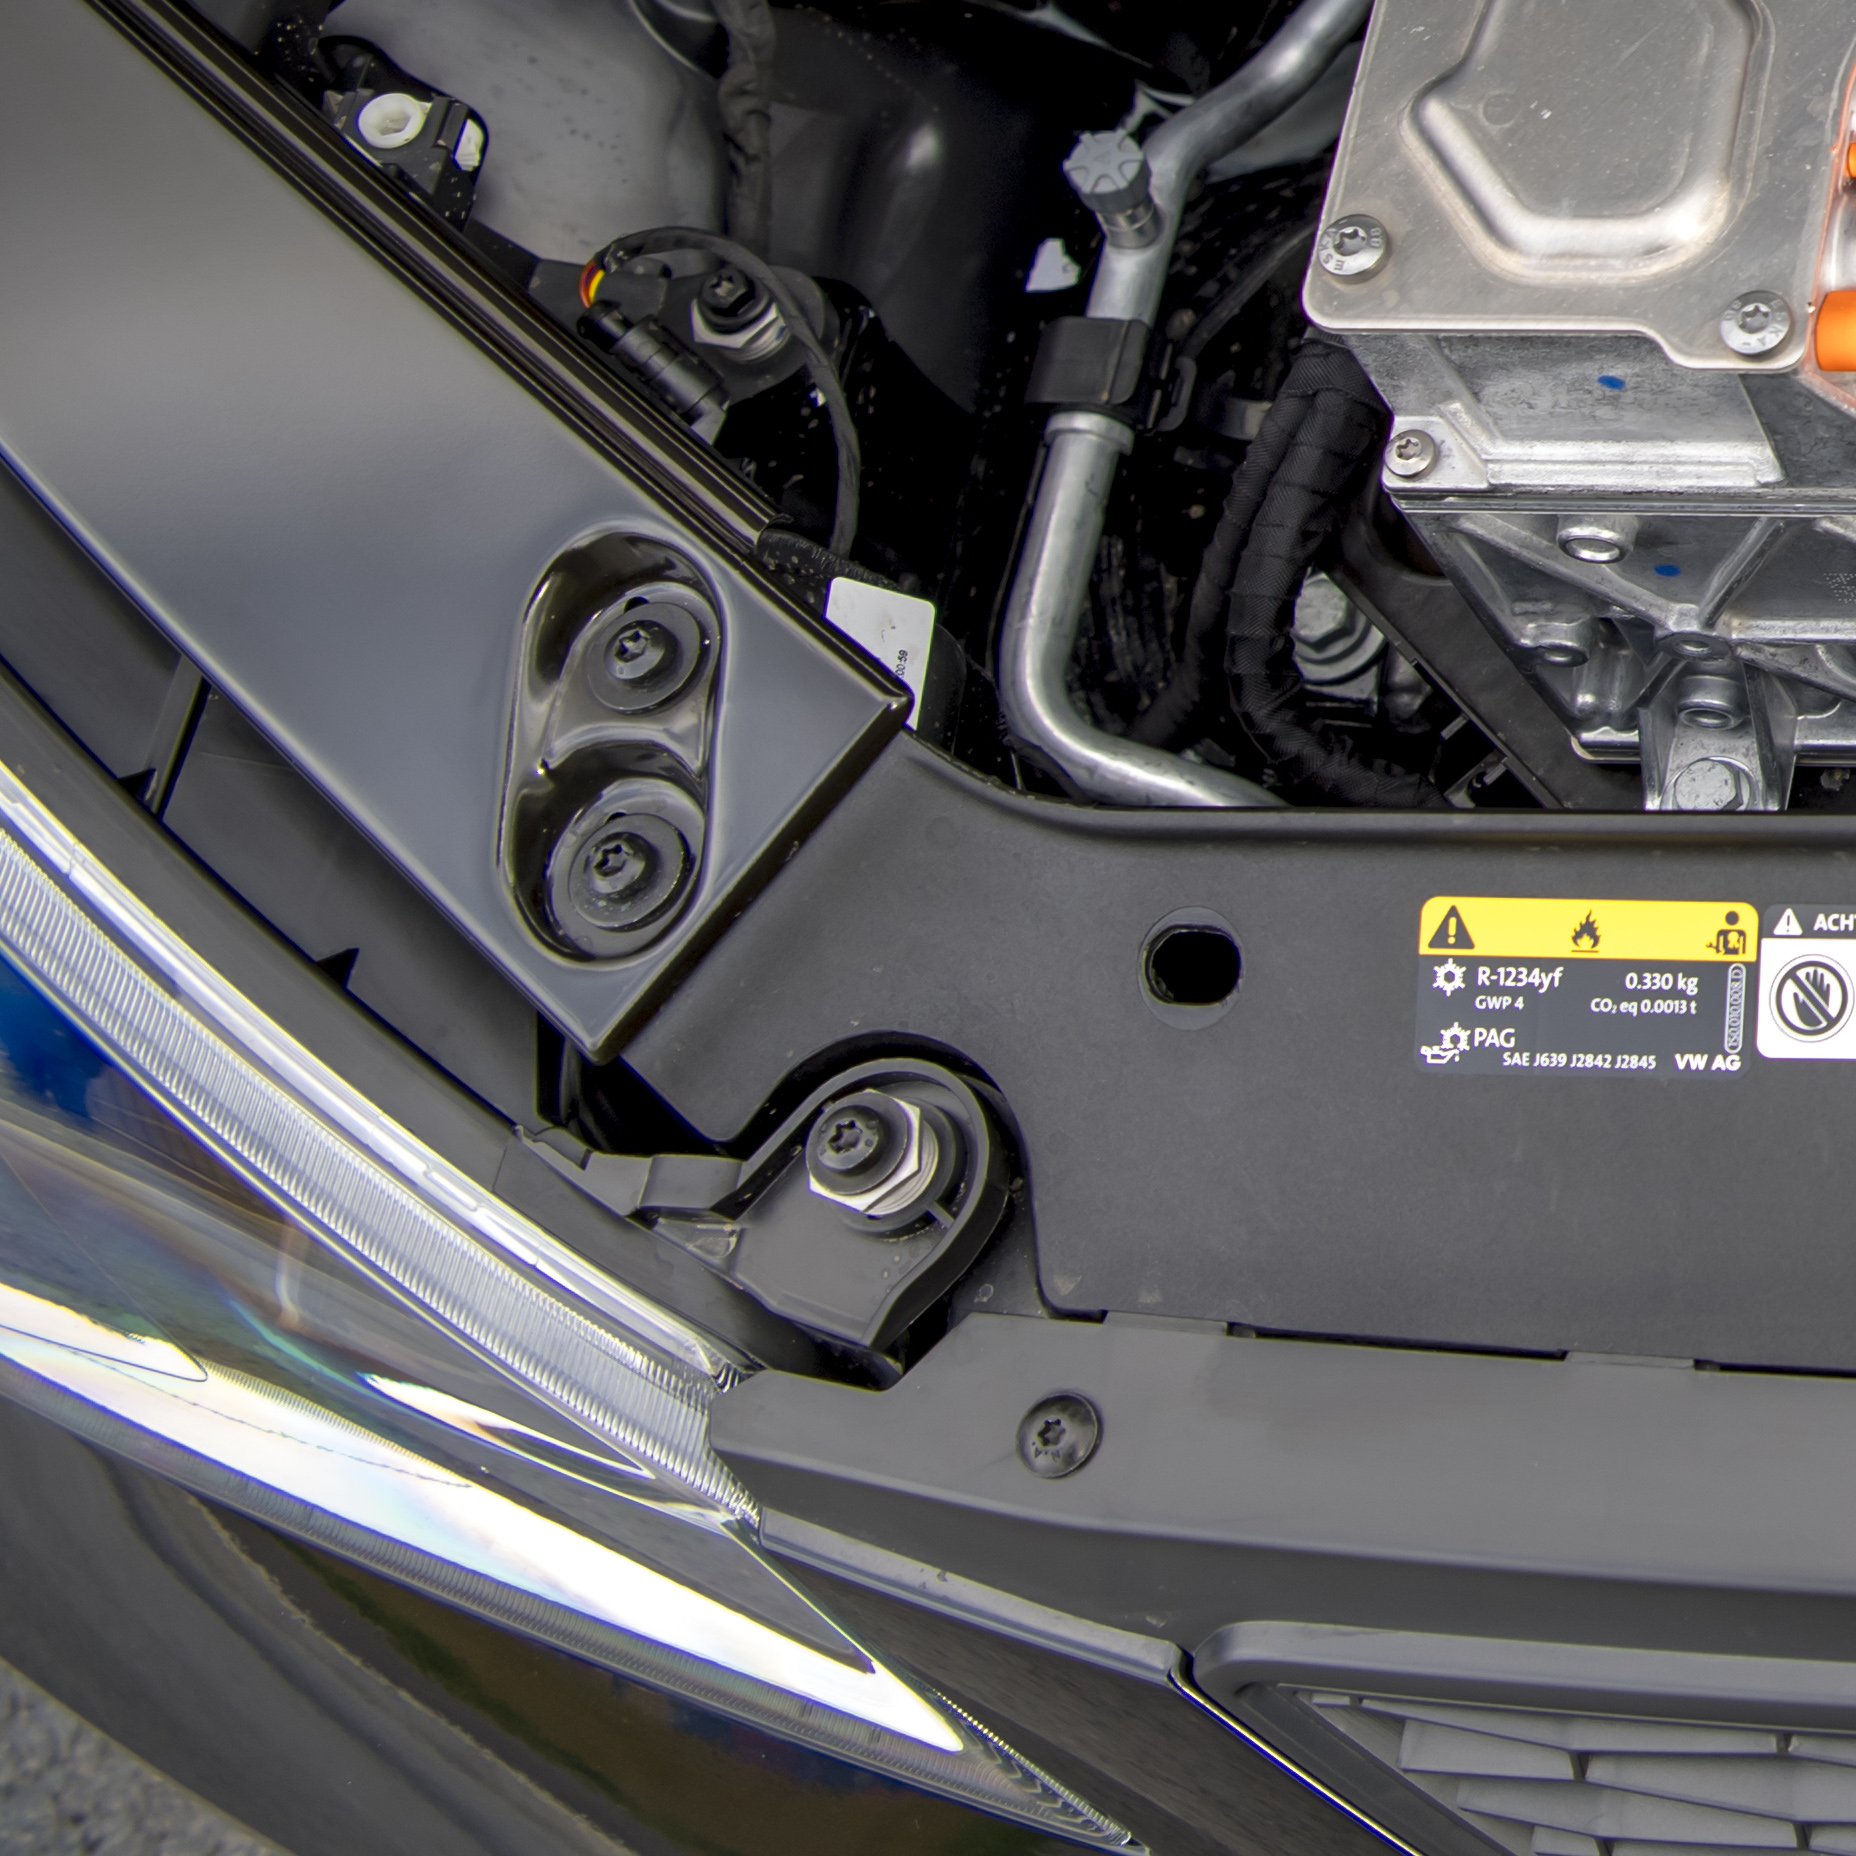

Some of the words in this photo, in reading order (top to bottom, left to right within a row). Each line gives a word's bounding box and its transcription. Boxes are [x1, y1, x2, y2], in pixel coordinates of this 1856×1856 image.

[1477, 966, 1564, 993] R-1234yf
[1625, 972, 1674, 991] 0.330
[1677, 973, 1698, 995] kg
[1474, 996, 1511, 1011] GWP
[1513, 996, 1525, 1011] 4
[1619, 1002, 1638, 1017] eq
[1640, 999, 1687, 1014] 0.0013
[1689, 1000, 1698, 1015] t
[1474, 1027, 1517, 1049] PAG
[1502, 1052, 1530, 1067] SAE
[1533, 1052, 1567, 1068] J639
[1570, 1053, 1612, 1069] J2842
[1614, 1054, 1656, 1070] J2845
[1674, 1054, 1708, 1071] VW
[1711, 1054, 1742, 1071] AG
